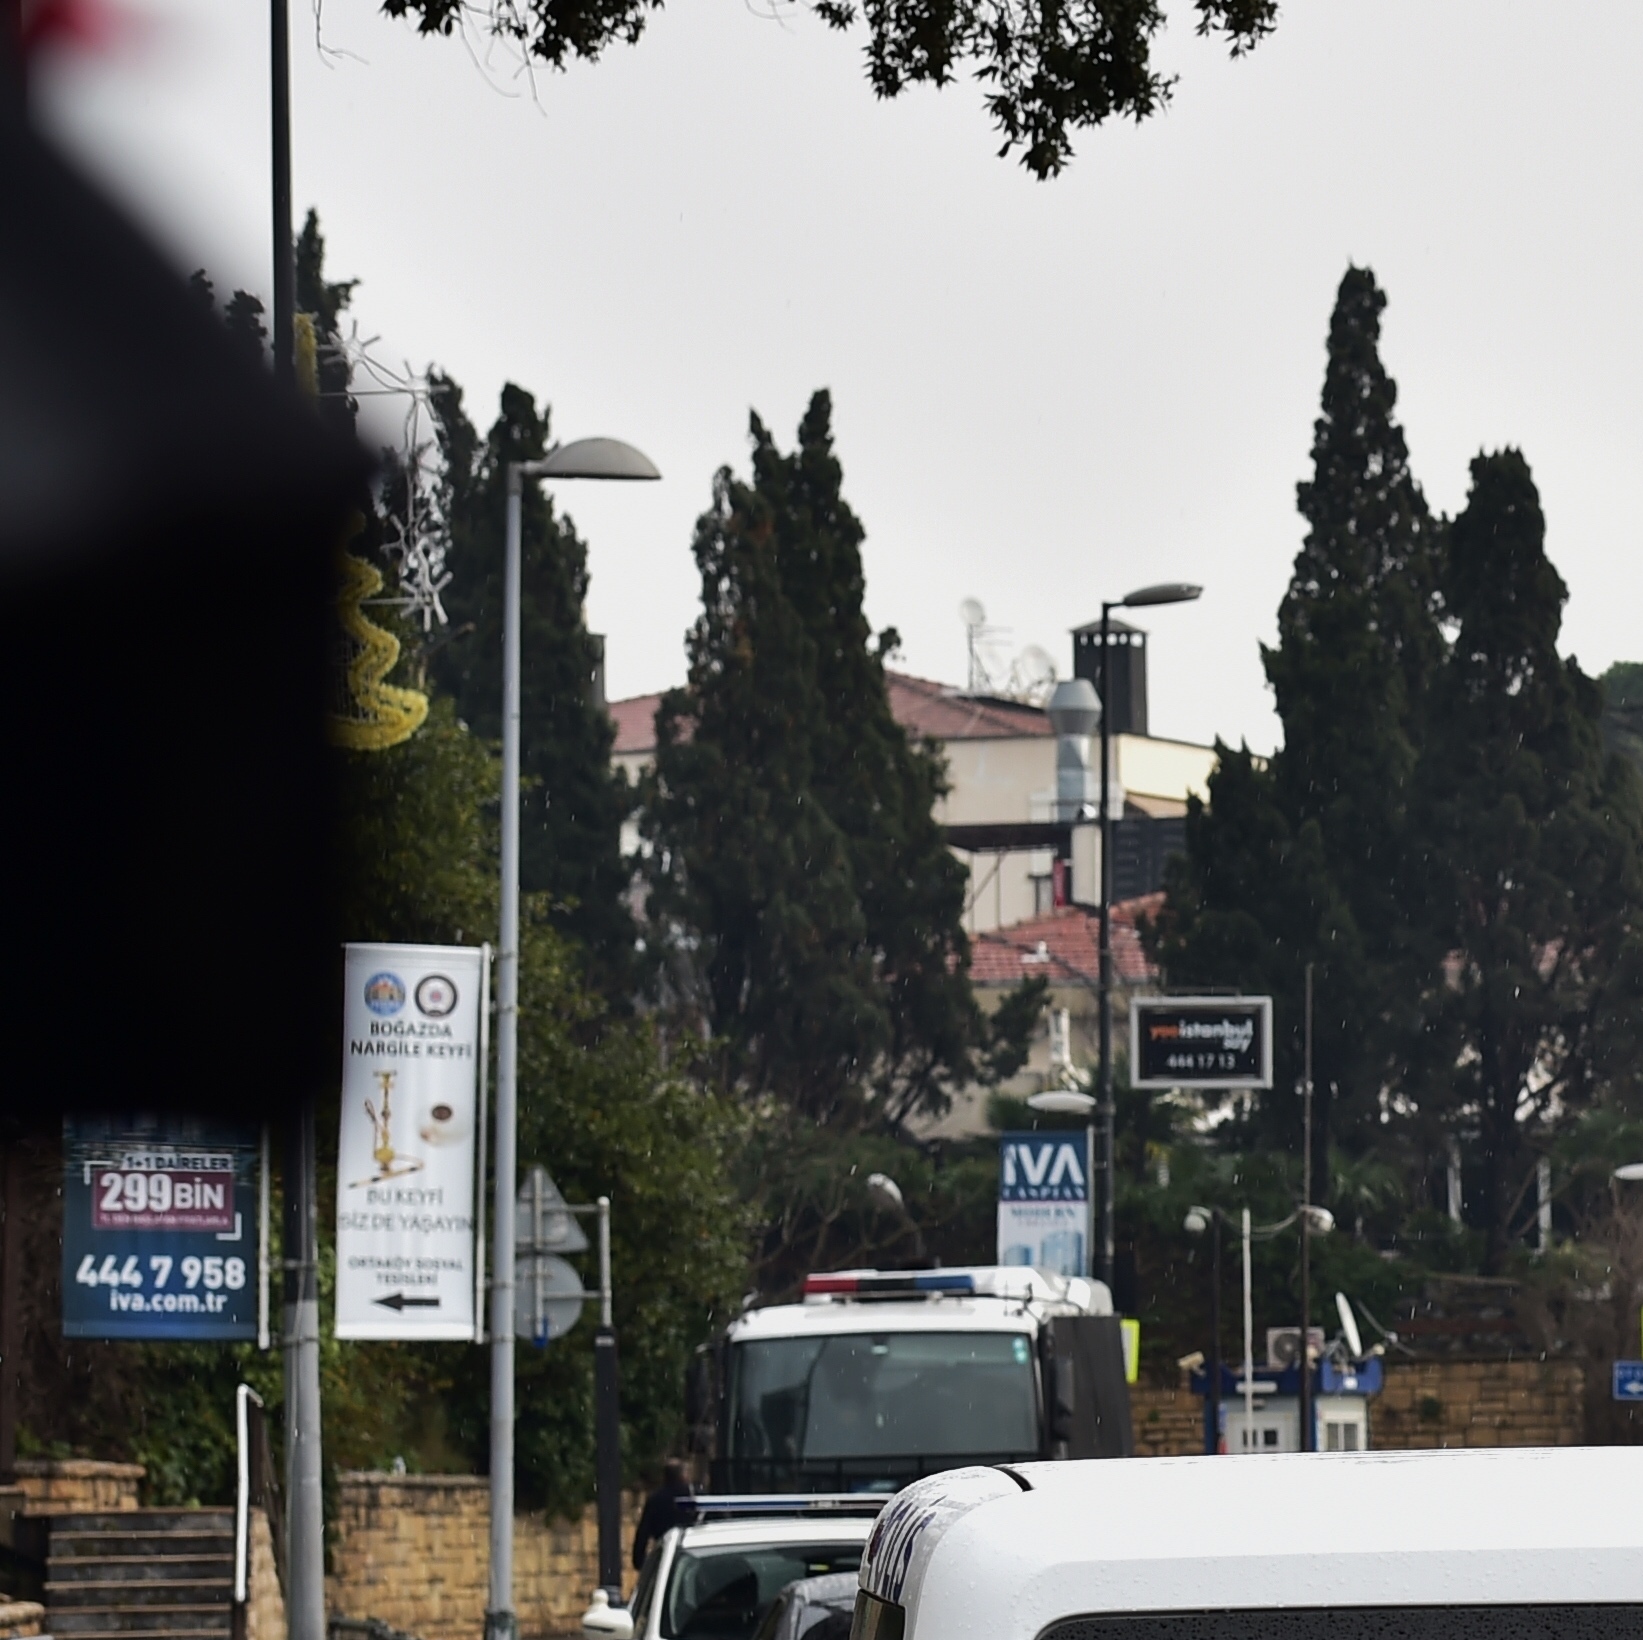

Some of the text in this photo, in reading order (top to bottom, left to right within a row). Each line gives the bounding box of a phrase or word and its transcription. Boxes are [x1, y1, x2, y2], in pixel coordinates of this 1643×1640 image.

[370, 1020, 452, 1037] BOĞAZDA
[350, 1039, 472, 1058] NARGİLE KEYFİ
[155, 1154, 230, 1170] DAİRELER
[99, 1172, 225, 1212] 299 BİN
[76, 1254, 246, 1290] 444 7 958
[109, 1288, 228, 1313] iva.com.tr
